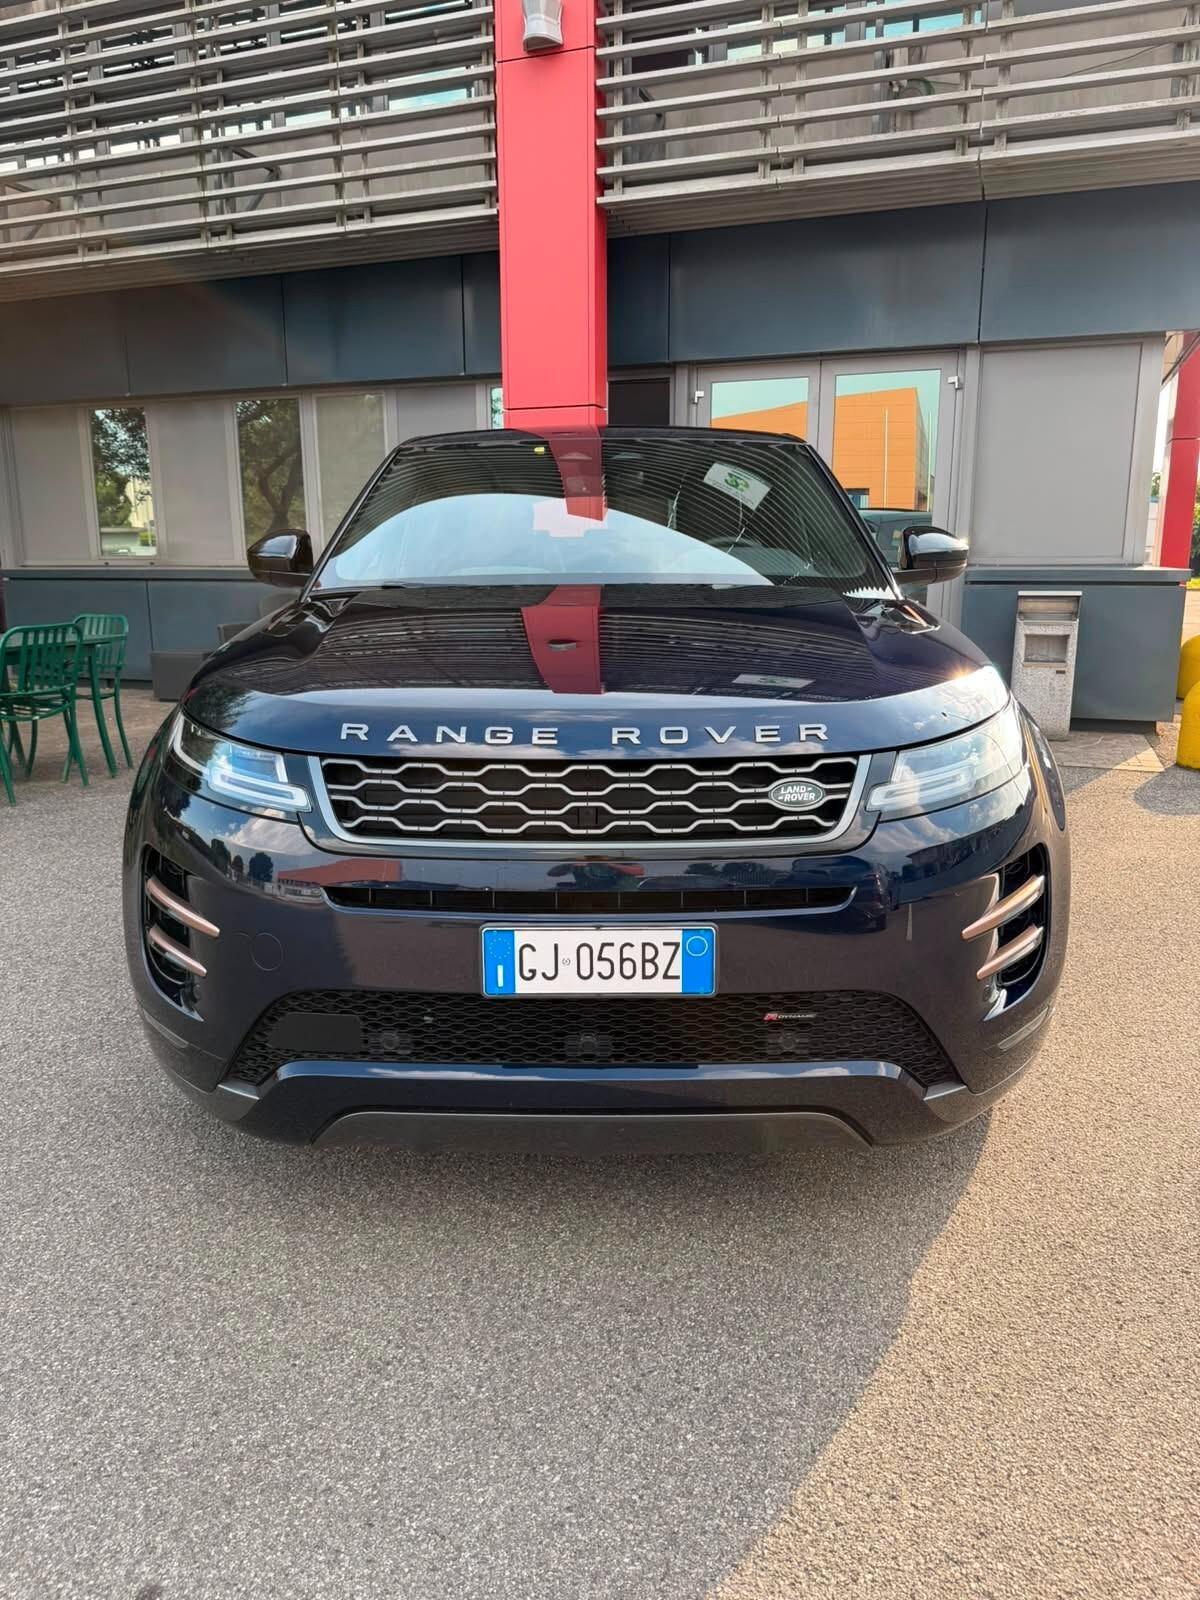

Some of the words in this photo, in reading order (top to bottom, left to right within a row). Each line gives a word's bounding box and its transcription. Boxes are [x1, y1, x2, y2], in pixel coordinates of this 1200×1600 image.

[339, 722, 559, 745] RANGE
[611, 723, 829, 745] ROVER
[518, 943, 559, 982] GJ
[576, 941, 681, 981] 056BZ
